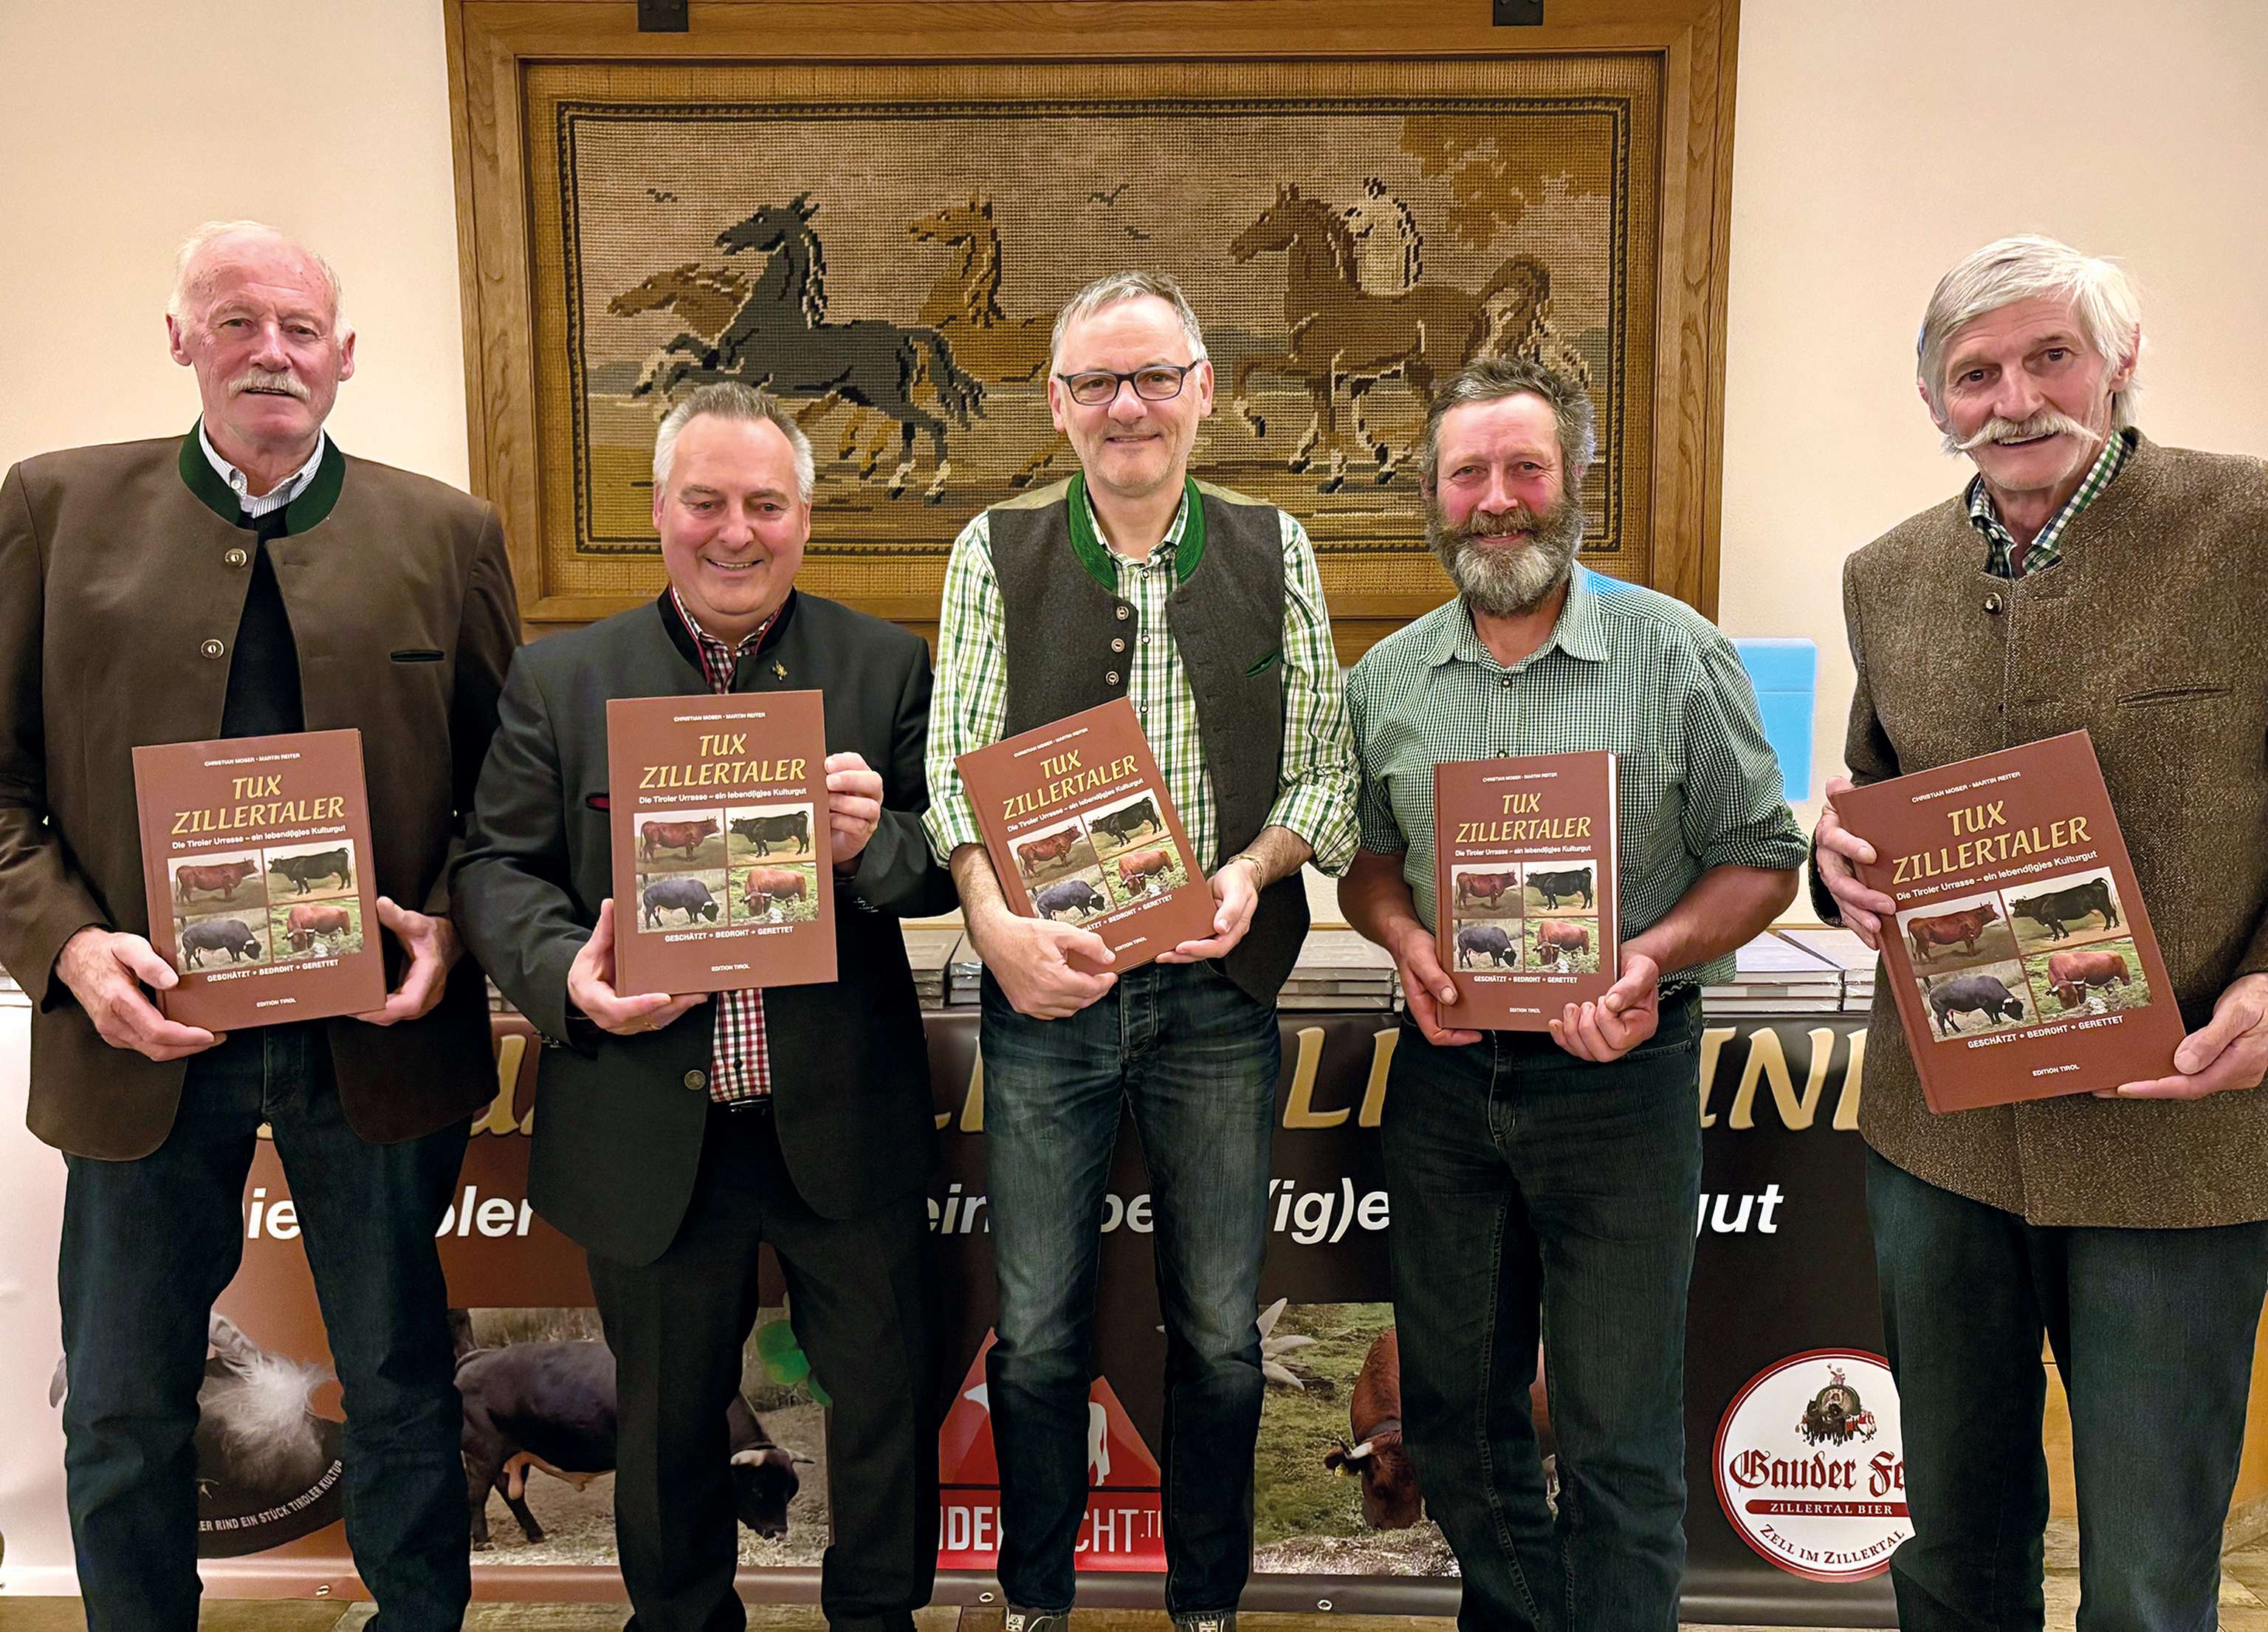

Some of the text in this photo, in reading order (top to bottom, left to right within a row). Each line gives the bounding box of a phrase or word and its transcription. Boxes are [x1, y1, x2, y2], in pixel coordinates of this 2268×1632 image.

[700, 733, 747, 757] TUX
[639, 758, 806, 789] ZILLERTALER
[1040, 749, 1082, 779] TUX
[233, 775, 283, 800] TUX
[774, 788, 807, 797] Kulturgut
[1003, 755, 1139, 820] ZILLERTALER
[1911, 772, 2021, 803] CHRISTIAN MOSER MARTIN REITER
[171, 796, 345, 834] ZILLERTALER
[1019, 817, 1039, 828] Tiroler
[1116, 778, 1144, 792] Kulturgut
[1502, 793, 1542, 815] TUX
[1948, 800, 2007, 836] TUX
[187, 839, 212, 847] Tiroler
[213, 836, 244, 845] Urrasse
[312, 825, 346, 834] Kulturgut
[1455, 817, 1592, 843] ZILLERTALER
[1892, 816, 2092, 885] ZILLERTALER
[1896, 850, 2097, 901] Die Tiroler Urrasse ein lebend(ig)es Kulturgut
[1143, 894, 1172, 910] GERETTET
[665, 926, 794, 942] GESCHÄTZT BEDROHT GERETTET
[207, 959, 339, 982] GESCHÄTZT BEDROHT GERETTET
[1968, 1015, 2123, 1049] GESCHÄTZT BEDROHT GERETTET
[2032, 1067, 2058, 1077] EDITION
[242, 1187, 303, 1239] ie
[215, 1518, 239, 1530] RIND
[240, 1516, 258, 1527] EIN
[258, 1504, 292, 1524] STÜCK
[288, 1484, 324, 1512] TIROLER
[1770, 1503, 1892, 1515] ZILLERTAL BIER
[1760, 1524, 1906, 1565] ZELL IM ZILLERTAL
